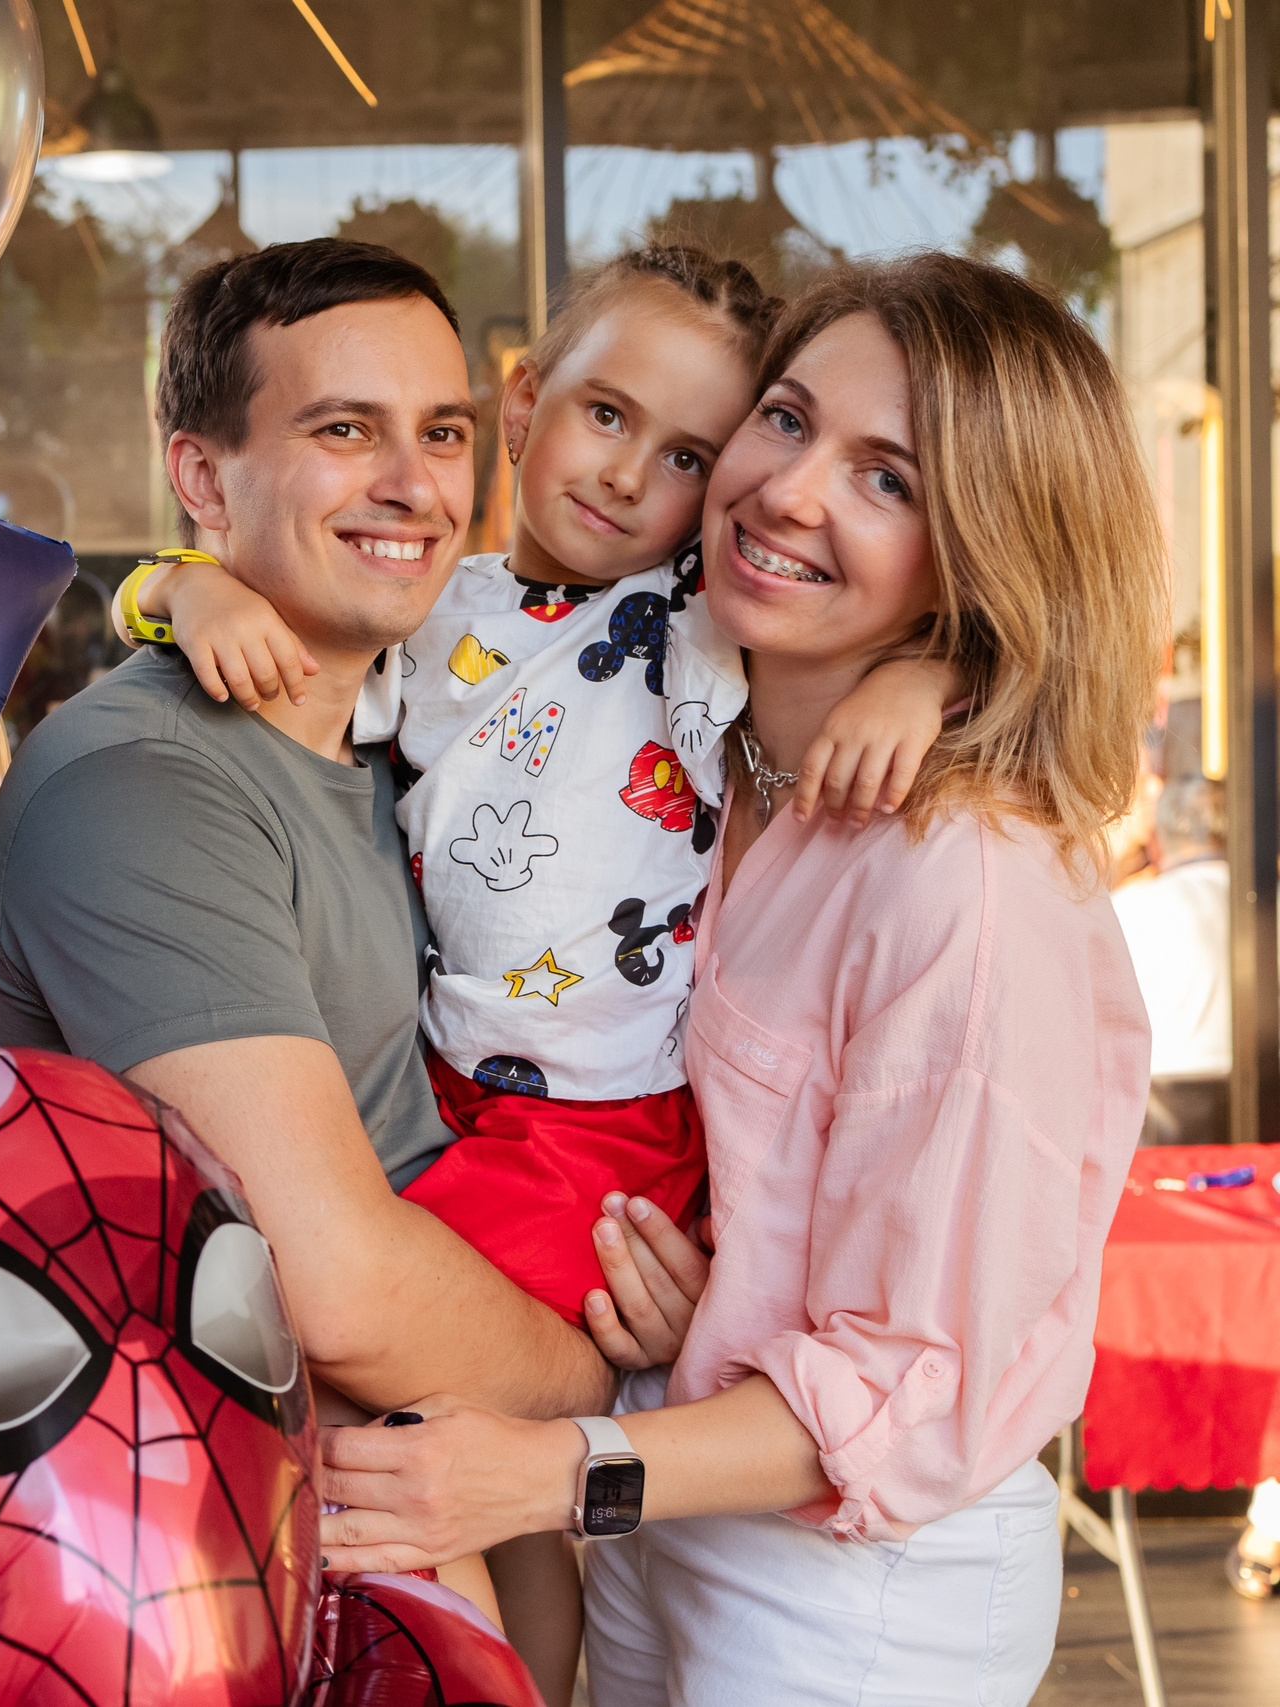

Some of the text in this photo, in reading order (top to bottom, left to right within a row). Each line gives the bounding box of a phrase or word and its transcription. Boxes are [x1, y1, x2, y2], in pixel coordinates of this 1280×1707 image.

[624, 601, 635, 614] Z
[610, 613, 664, 630] U V W
[612, 629, 621, 641] S
[629, 633, 640, 643] R
[596, 642, 609, 655] O
[615, 646, 627, 656] N
[580, 654, 590, 664] J
[611, 659, 623, 668] H
[584, 669, 596, 680] D
[468, 687, 566, 779] M
[592, 1507, 617, 1518] 19:51
